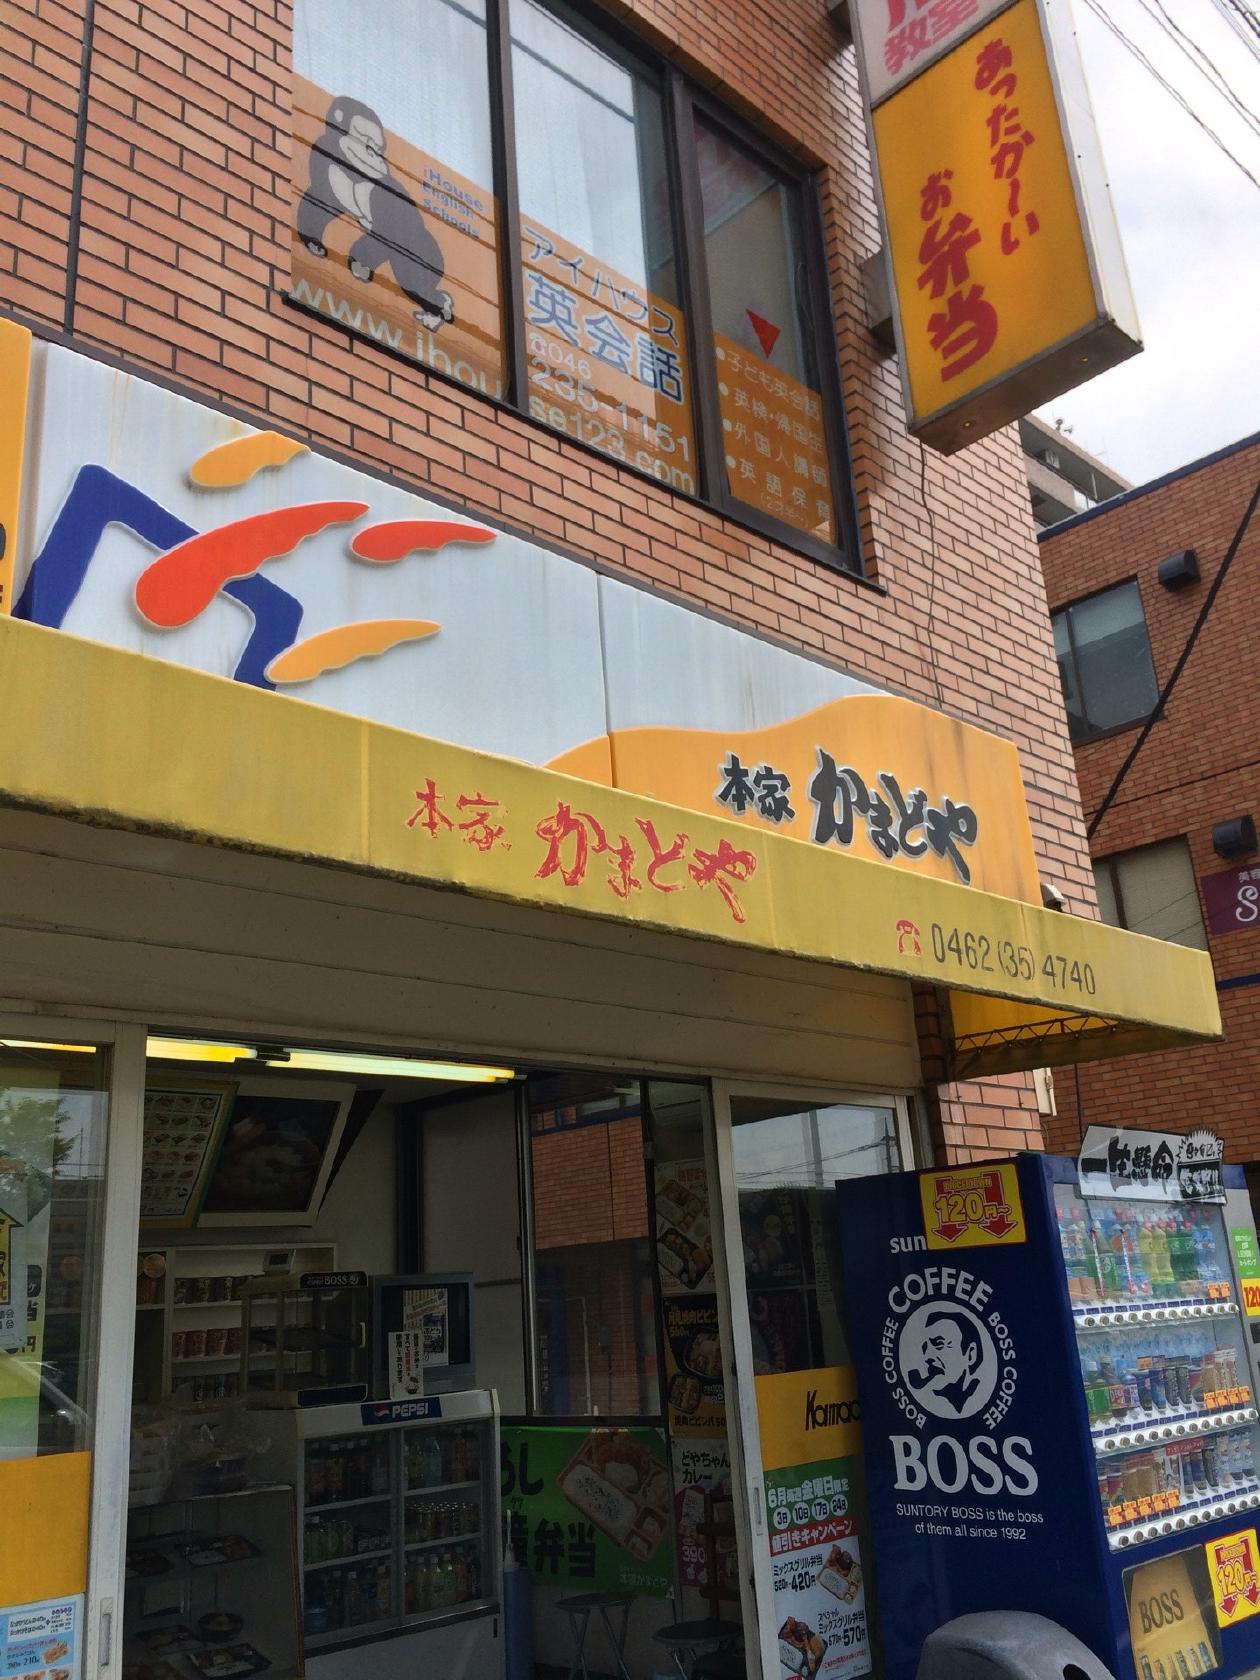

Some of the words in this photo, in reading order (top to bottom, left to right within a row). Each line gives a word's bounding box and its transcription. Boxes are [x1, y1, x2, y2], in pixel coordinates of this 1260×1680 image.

[884, 0, 978, 76] 教室
[974, 38, 1040, 256] あったかーい
[422, 180, 474, 220] English
[423, 198, 480, 240] Schools
[525, 226, 680, 347] アイハウス
[917, 168, 999, 382] お弁当
[290, 278, 503, 401] wwwihou
[528, 272, 684, 405] 英会話
[531, 358, 690, 463] 235-1151
[528, 395, 695, 496] se123com
[716, 751, 796, 826] 本家
[808, 746, 979, 886] かまどや
[406, 778, 512, 851] 本家
[535, 800, 757, 924] かまどや
[888, 1267, 993, 1313] COFFEE
[882, 1316, 899, 1384] COFFEE
[988, 1311, 1016, 1361] BOSS
[391, 1402, 429, 1418] PEPSI
[893, 1387, 927, 1429] BOSS
[982, 1366, 1018, 1431] COFFEE
[681, 1450, 731, 1469] どやちゃん
[681, 1467, 713, 1483] カレー
[889, 1435, 1039, 1496] BOSS
[896, 1504, 949, 1517] SUNTORY
[951, 1506, 984, 1520] BOSS
[986, 1508, 996, 1521] is
[998, 1508, 1015, 1522] the
[1018, 1510, 1044, 1523] boss
[915, 1522, 925, 1534] of
[927, 1523, 952, 1536] them
[955, 1524, 967, 1537] all
[969, 1526, 998, 1538] since
[1001, 1527, 1027, 1540] 1992
[1138, 1588, 1185, 1634] BOSS
